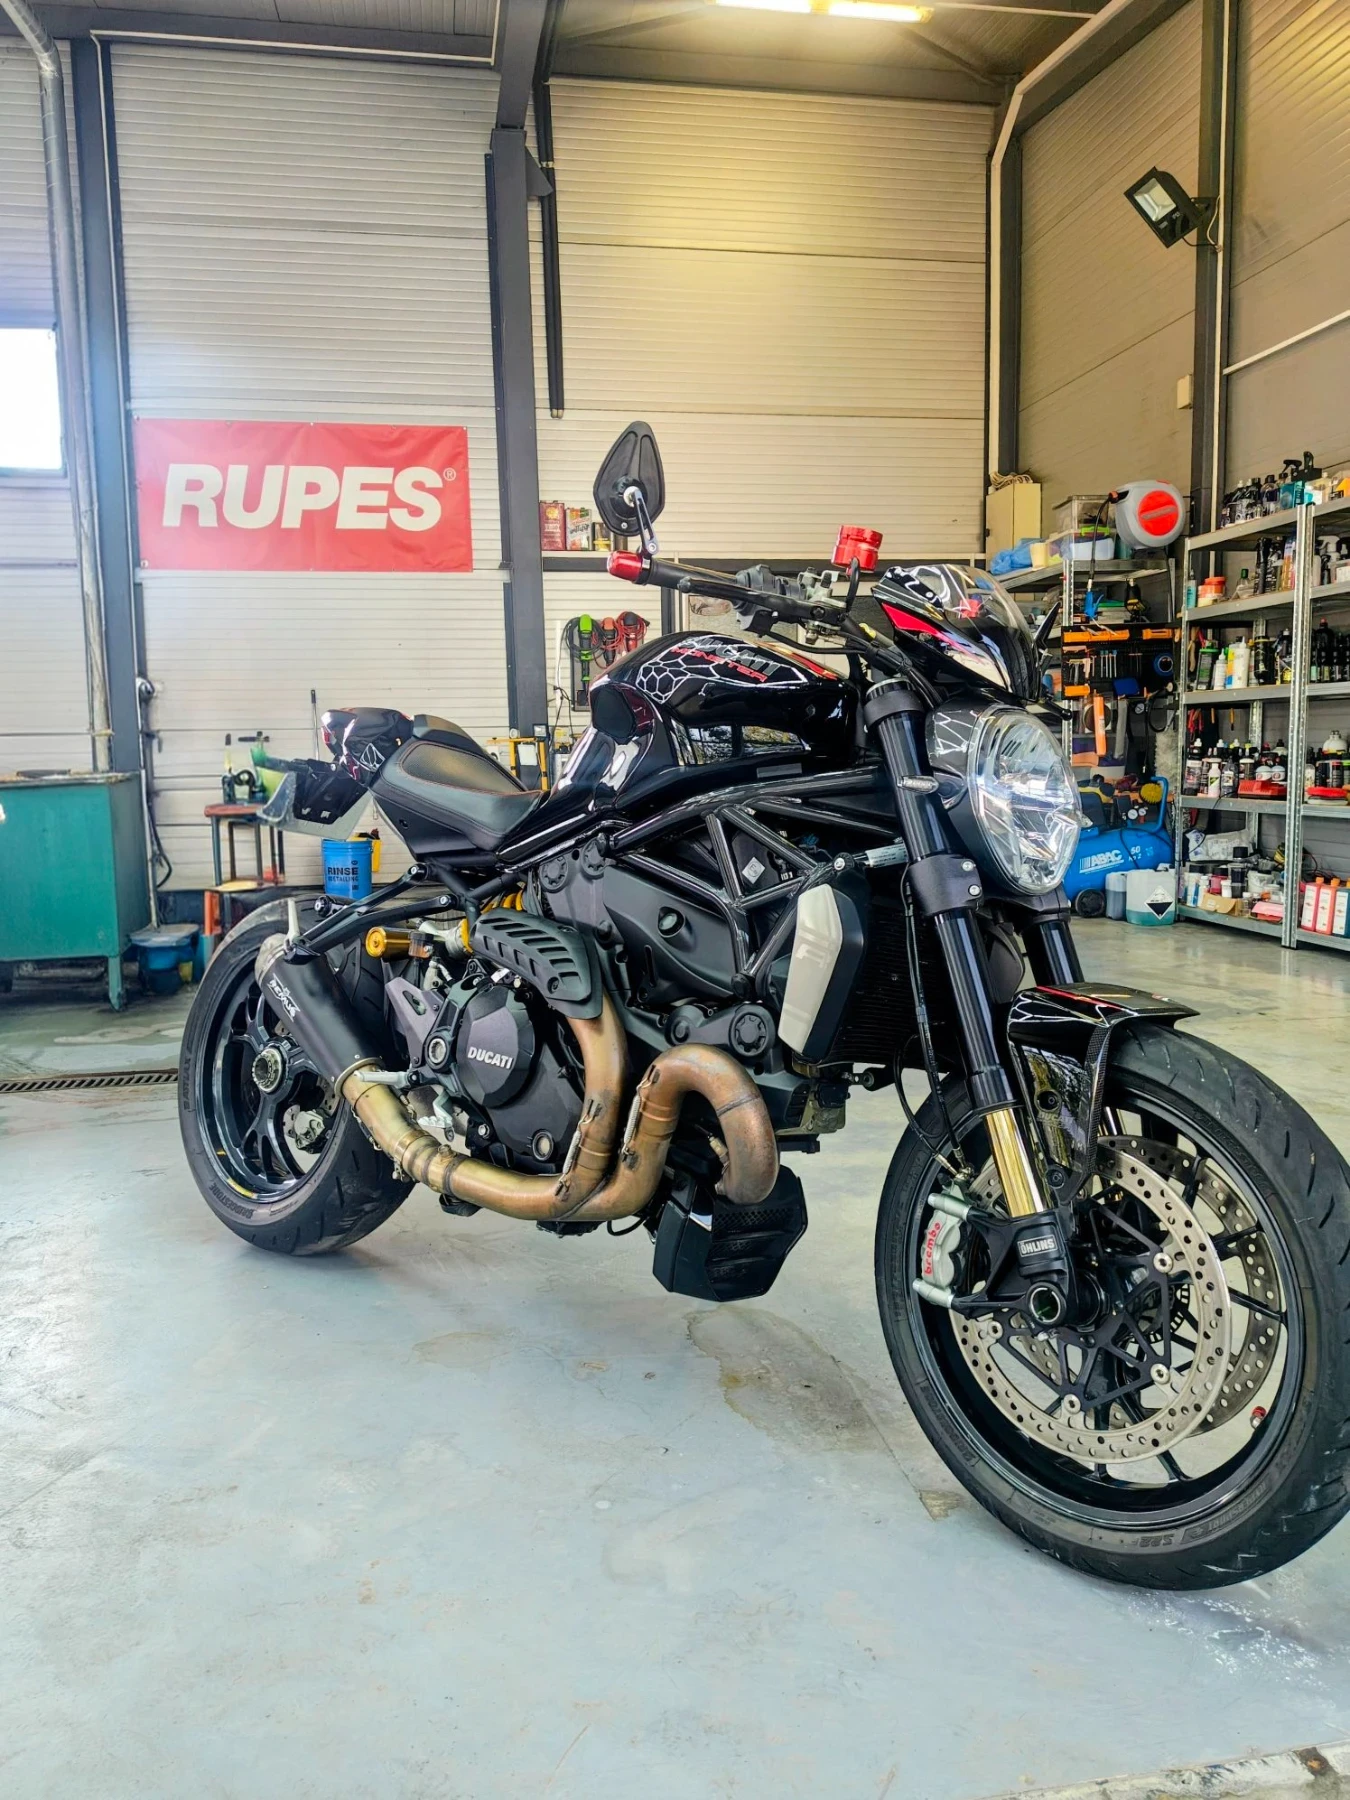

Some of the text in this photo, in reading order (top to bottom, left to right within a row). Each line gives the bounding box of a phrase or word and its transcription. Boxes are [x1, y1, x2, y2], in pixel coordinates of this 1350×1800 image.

[1091, 849, 1123, 867] ABAC
[327, 866, 359, 876] RINSE
[268, 978, 299, 1018] REMUS
[467, 1046, 513, 1070] DUCATI
[208, 1182, 255, 1219] BRIDGESTONE
[924, 1221, 941, 1275] brembo
[1020, 1238, 1055, 1255] ÖHLINS
